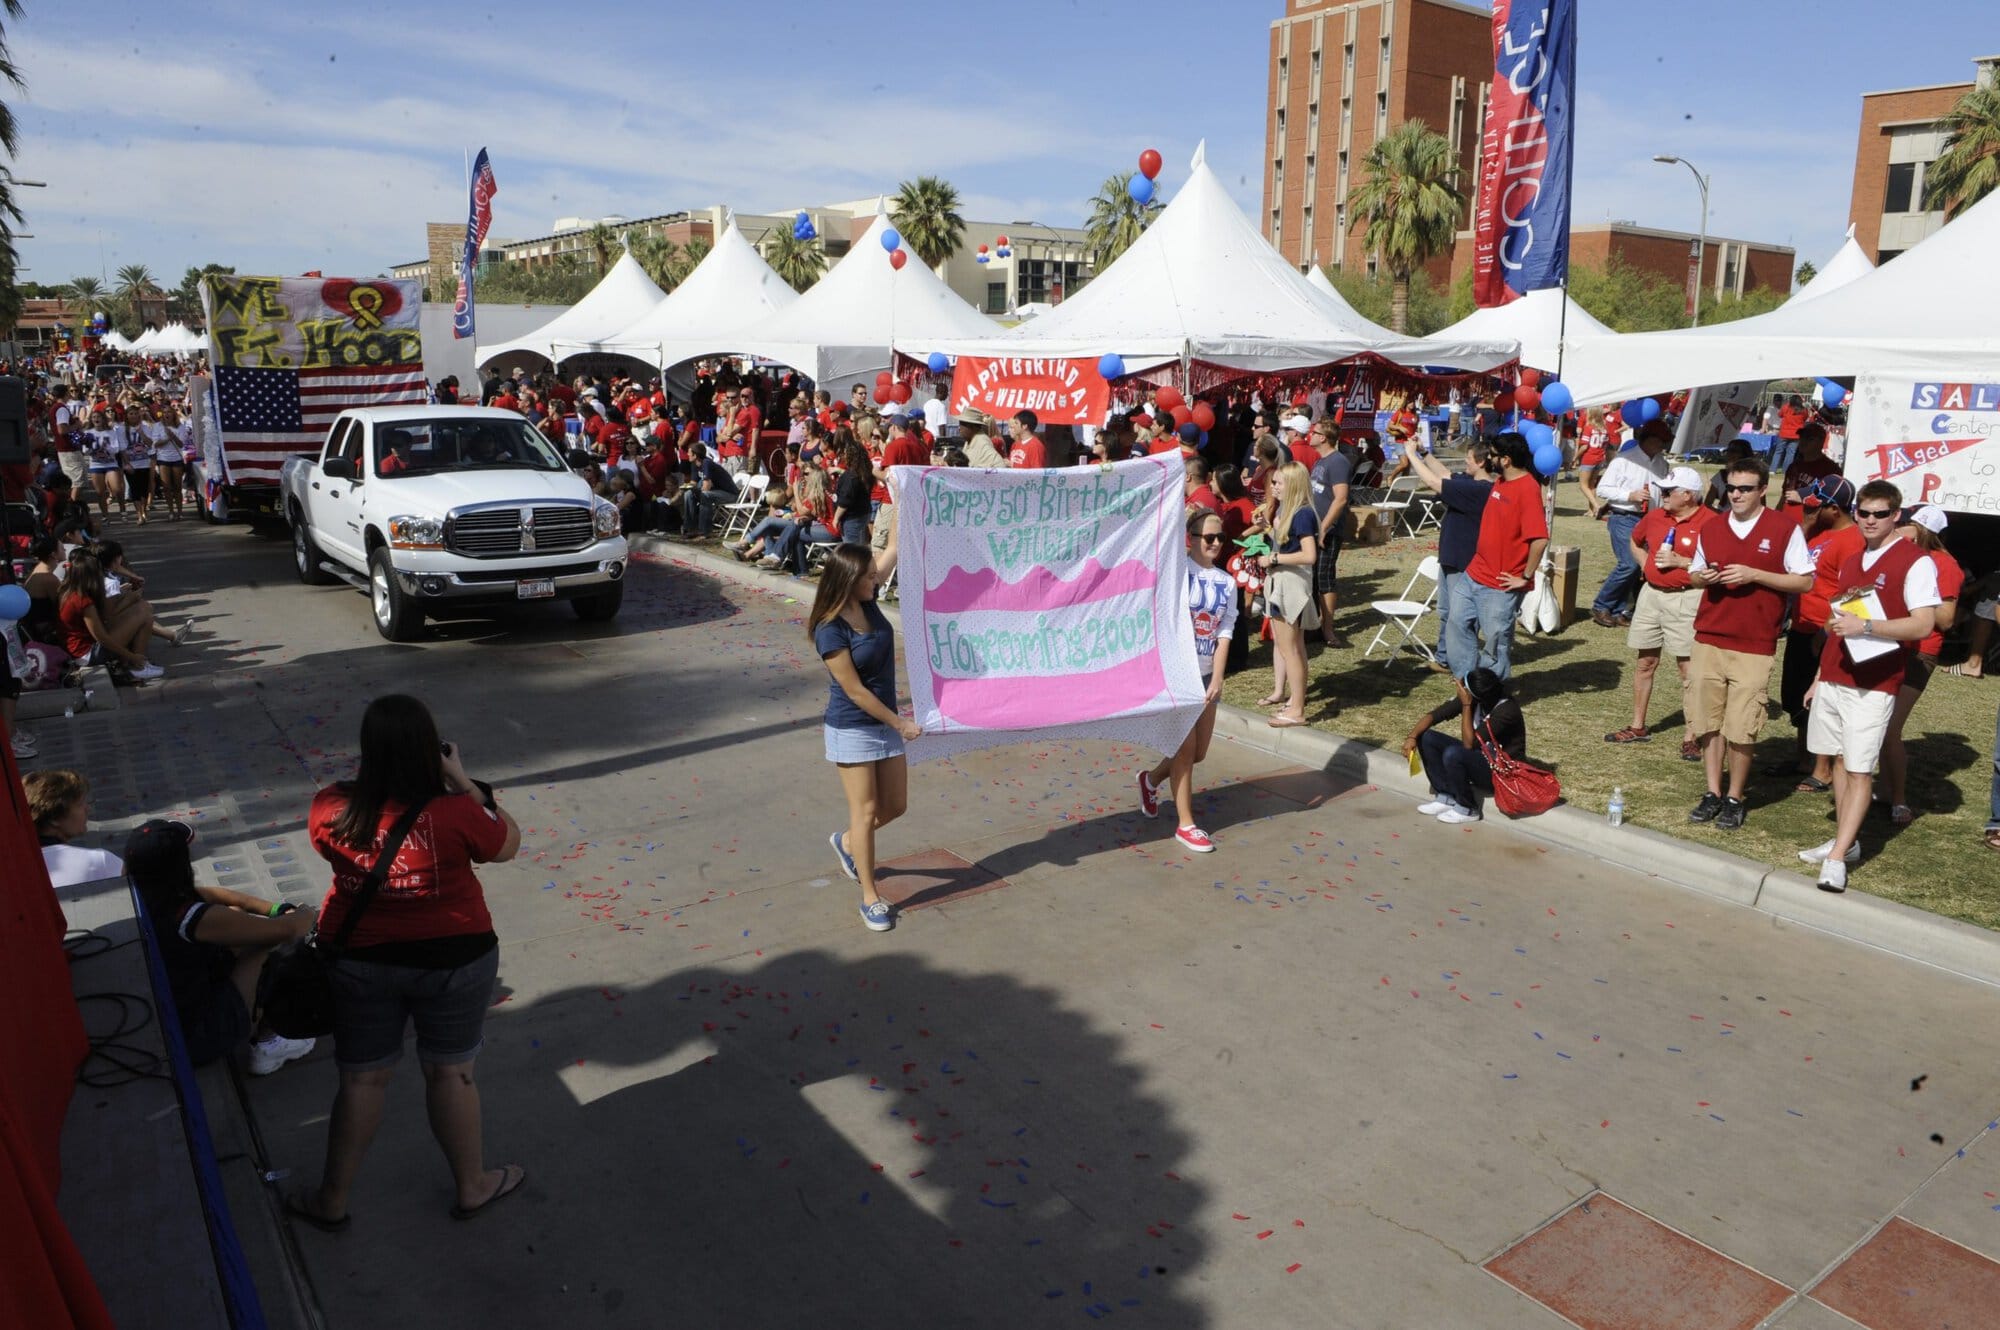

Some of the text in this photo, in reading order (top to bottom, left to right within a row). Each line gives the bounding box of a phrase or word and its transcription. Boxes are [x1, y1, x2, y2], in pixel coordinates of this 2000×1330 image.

[204, 274, 289, 324] WE
[956, 358, 1008, 413] HAPPY
[1931, 413, 2000, 437] Center
[1888, 440, 1950, 475] Aged
[1969, 450, 1996, 476] to
[925, 476, 996, 528] Happy
[1038, 474, 1153, 523] Birthday
[929, 607, 1151, 674] Homecoming 2009
[354, 853, 409, 874] CLSS
